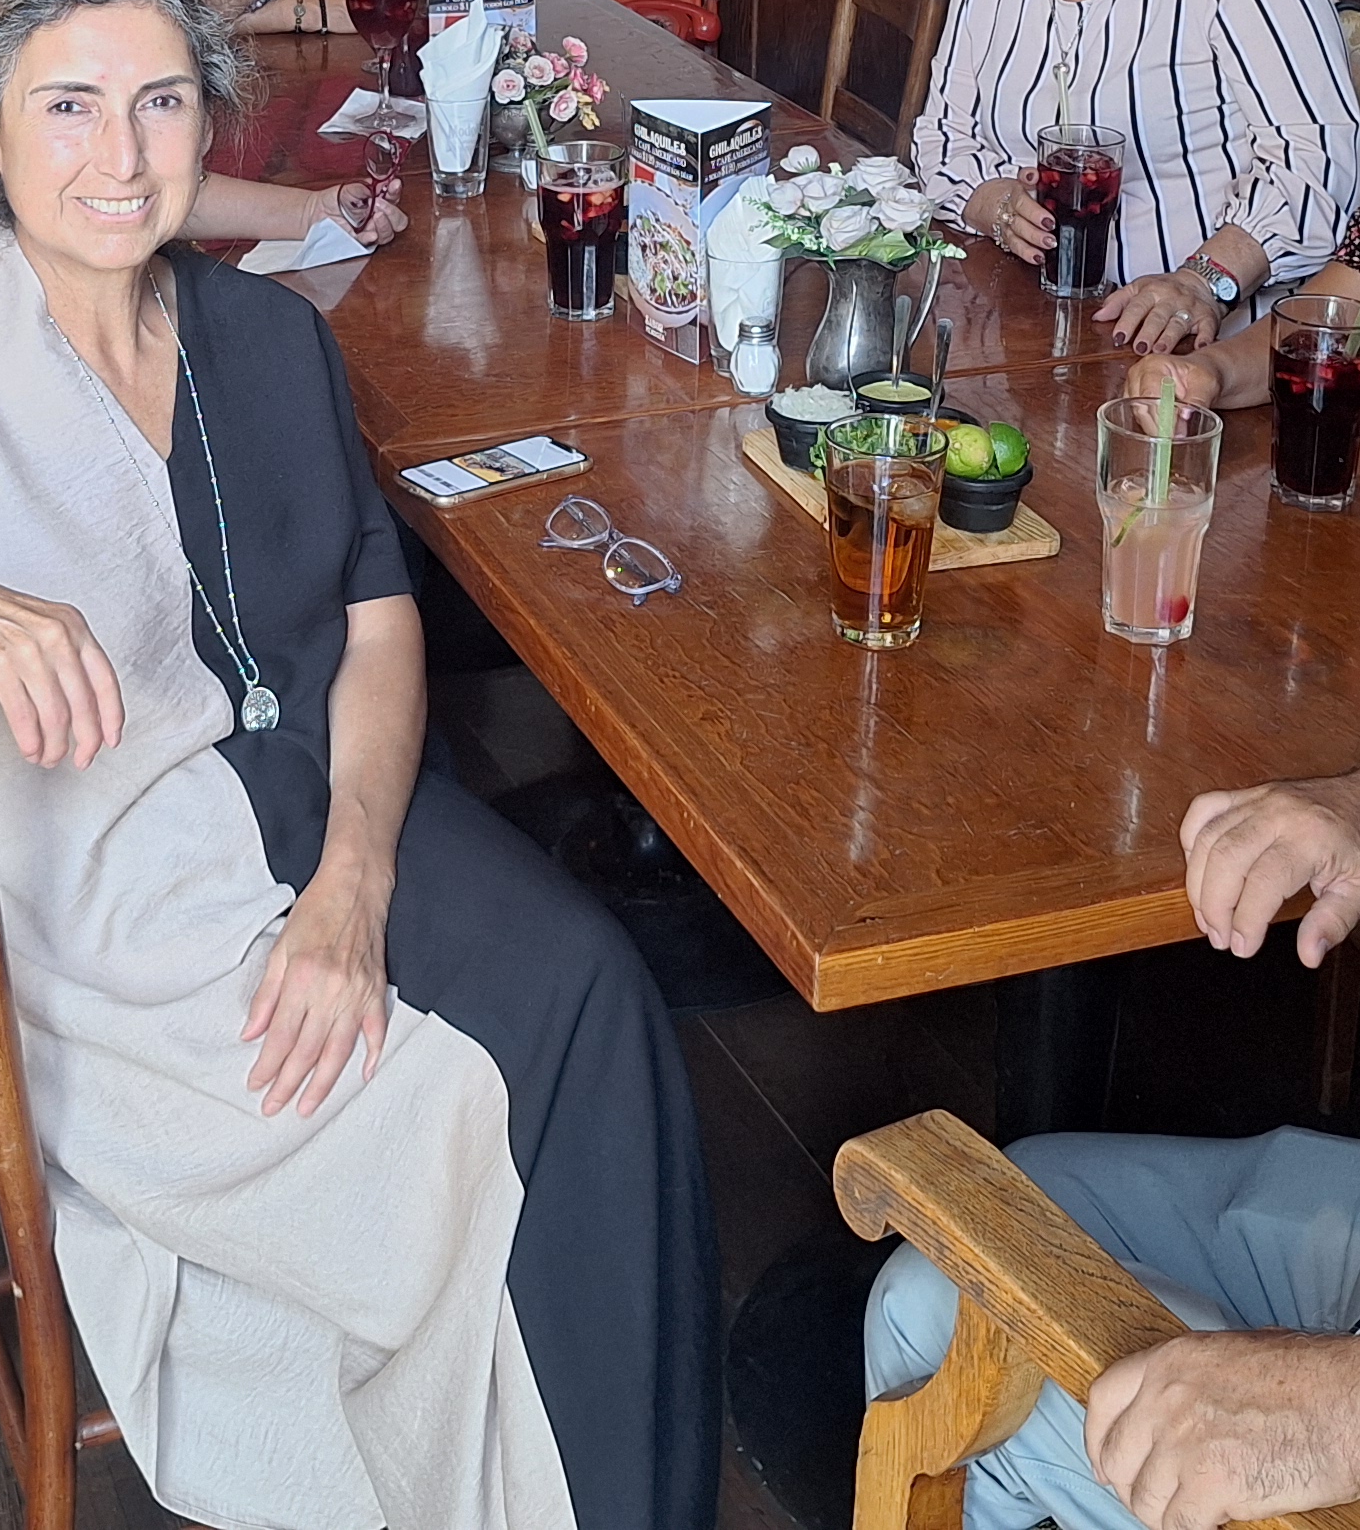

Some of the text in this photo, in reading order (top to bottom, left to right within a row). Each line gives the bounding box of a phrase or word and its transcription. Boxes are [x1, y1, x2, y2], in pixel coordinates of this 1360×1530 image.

[634, 123, 686, 156] CHILAQUILES
[709, 125, 762, 158] CHILAQUILES
[732, 140, 764, 160] AMERICANO
[651, 146, 687, 168] AMERICANO
